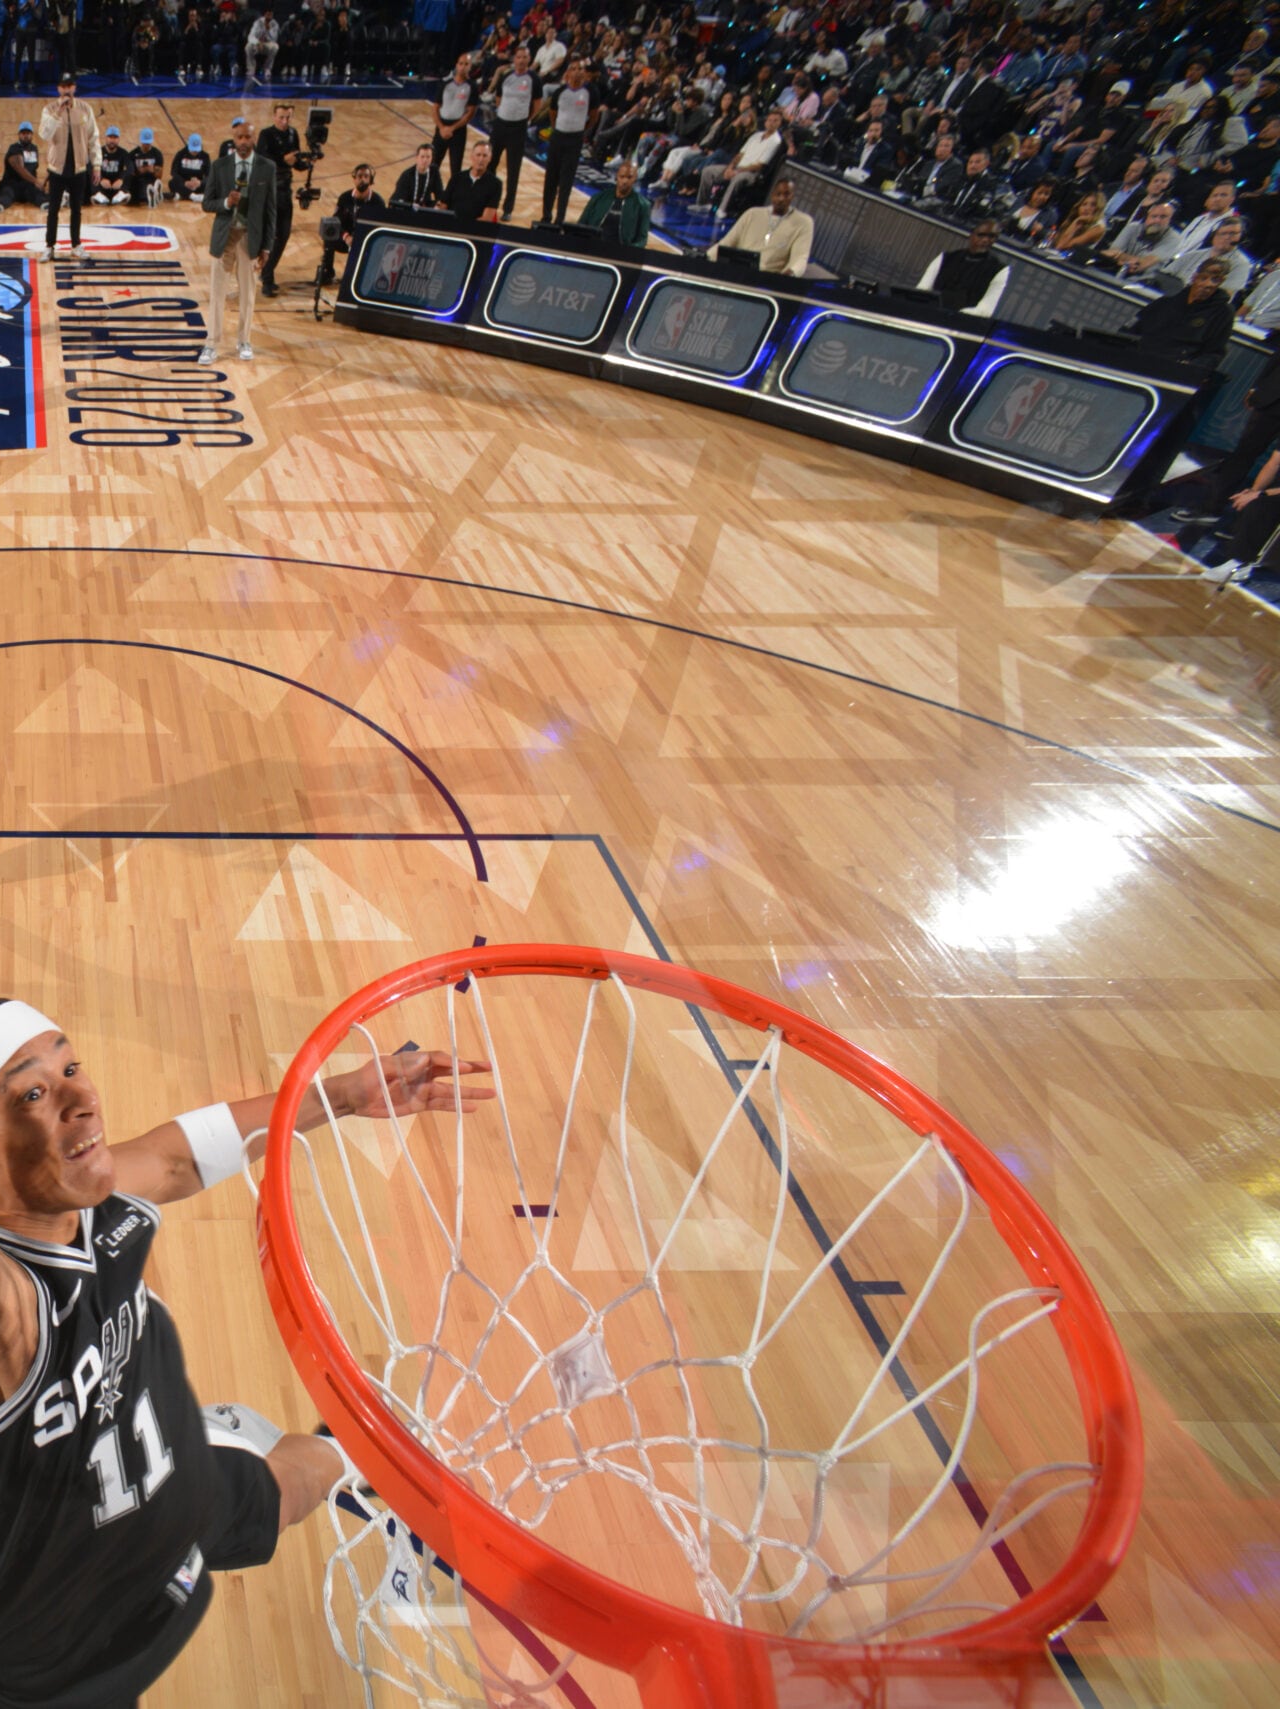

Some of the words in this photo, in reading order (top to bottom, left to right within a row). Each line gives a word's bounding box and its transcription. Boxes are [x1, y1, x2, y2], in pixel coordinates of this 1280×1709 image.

[403, 256, 436, 279] SLAM
[397, 276, 431, 298] DUNK
[538, 286, 595, 312] AT&T
[688, 310, 728, 336] SLAM
[679, 332, 719, 358] DUNK
[848, 356, 918, 388] AT&T
[64, 369, 254, 447] 2026
[1034, 396, 1090, 430] SLAM
[1020, 420, 1072, 456] DUNK
[106, 1214, 141, 1247] LEDGER
[33, 1279, 148, 1448] SPUR
[86, 1388, 175, 1530] 11
